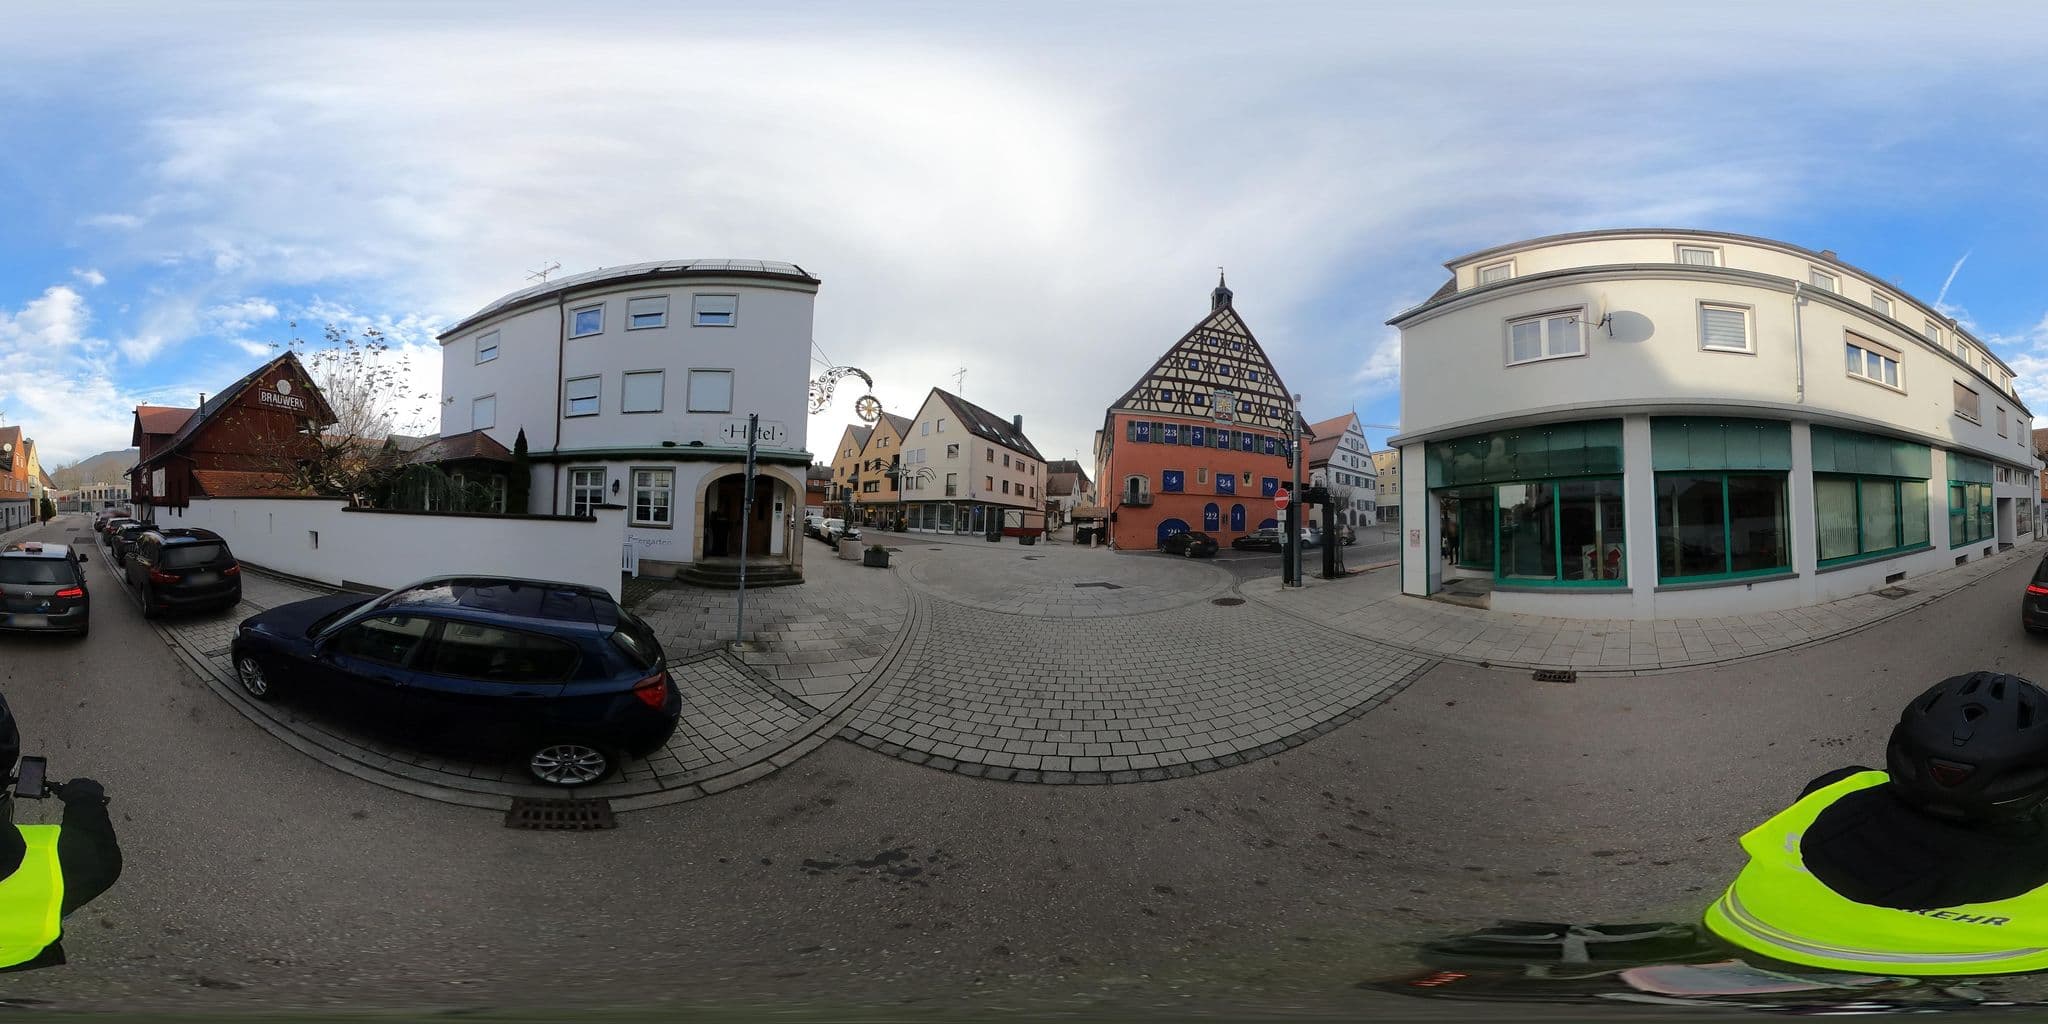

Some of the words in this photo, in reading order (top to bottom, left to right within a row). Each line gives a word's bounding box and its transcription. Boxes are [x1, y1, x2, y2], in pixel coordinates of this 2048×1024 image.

[261, 391, 305, 409] BRAUWERK
[730, 423, 775, 441] Htel
[1137, 426, 1149, 435] 12
[1165, 428, 1177, 438] 23
[1219, 478, 1232, 487] 24
[1206, 512, 1218, 521] 22
